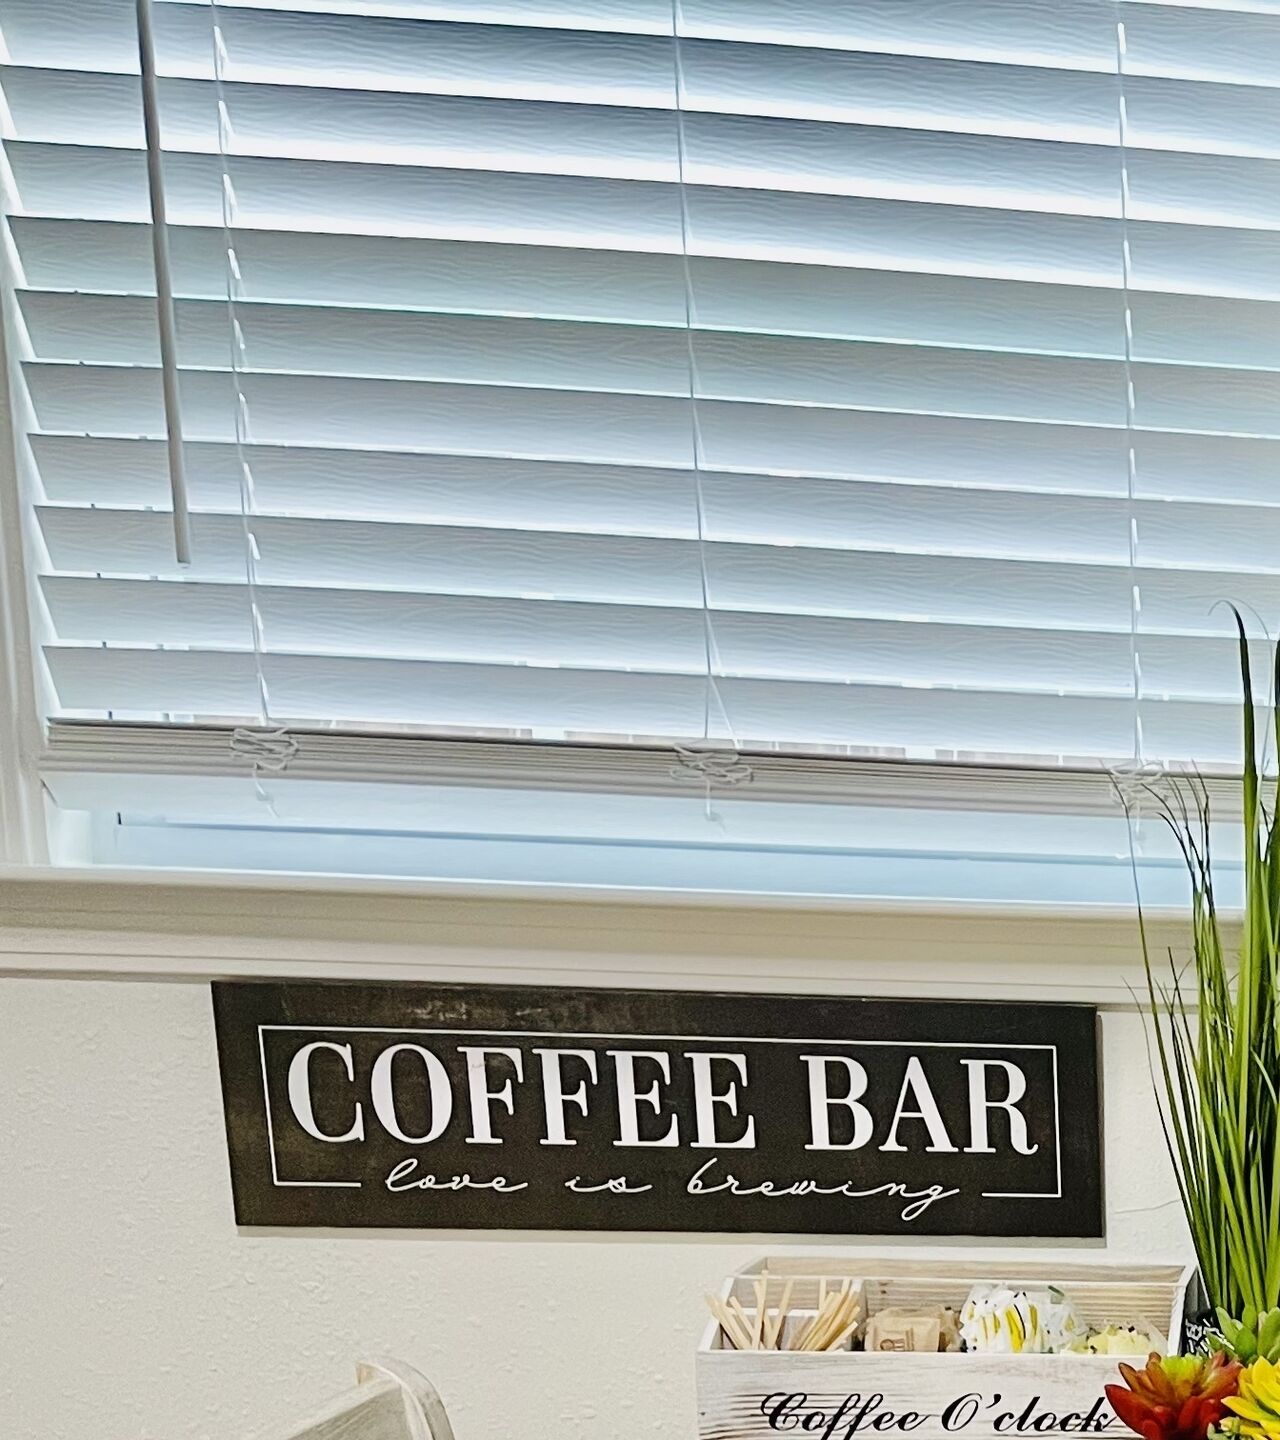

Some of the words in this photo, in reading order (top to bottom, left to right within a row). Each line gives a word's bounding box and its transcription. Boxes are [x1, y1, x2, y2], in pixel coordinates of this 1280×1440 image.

[286, 1040, 757, 1150] COFFEE
[799, 1054, 1040, 1156] BAR
[385, 1157, 528, 1195] love
[565, 1172, 652, 1195] is
[686, 1157, 960, 1222] brewing
[941, 1391, 1119, 1433] O'clock
